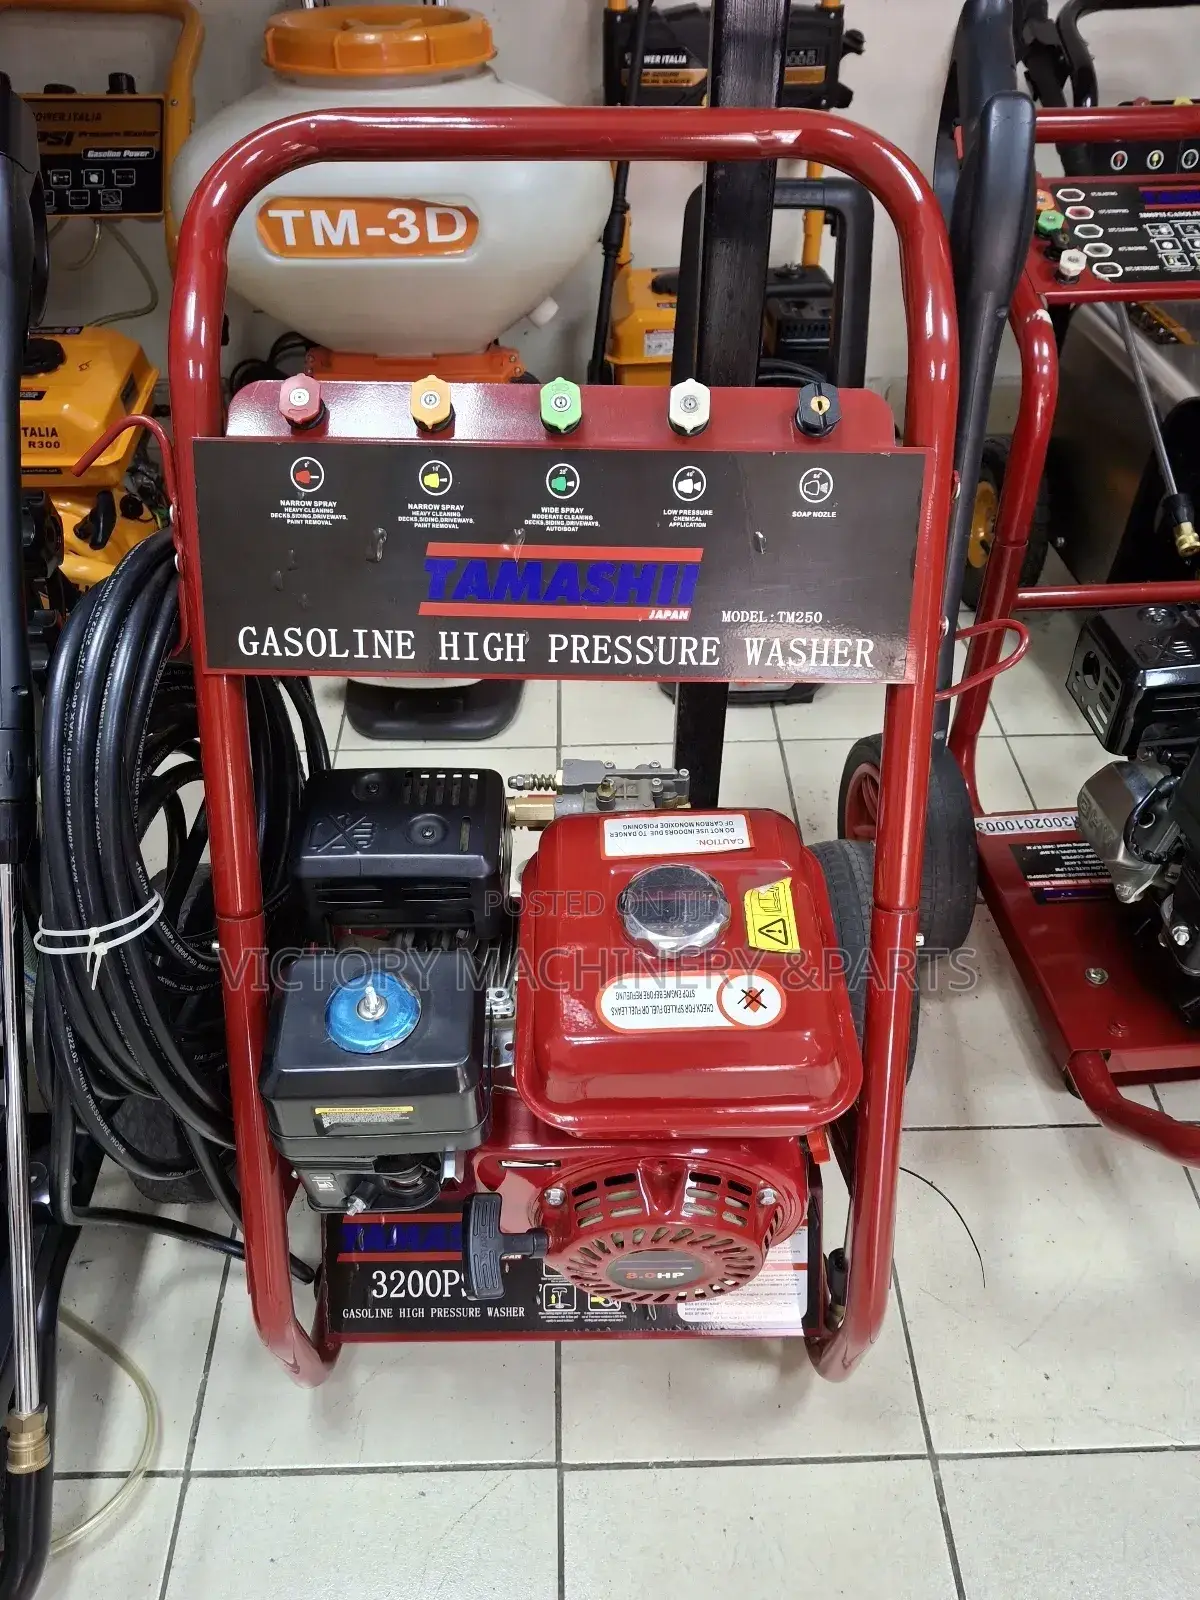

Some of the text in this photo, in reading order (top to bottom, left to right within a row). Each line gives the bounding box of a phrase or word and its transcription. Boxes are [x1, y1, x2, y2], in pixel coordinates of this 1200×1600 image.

[643, 55, 661, 63] WER
[268, 206, 468, 247] TM-3D
[22, 427, 59, 437] TALIA
[28, 441, 61, 449] R300
[424, 558, 700, 605] TAMASHII
[648, 609, 690, 620] JAPAN
[238, 626, 876, 669] GASOLINE HIGH PRESSURE WASHER
[696, 838, 744, 846] CAUTION:
[615, 989, 696, 1000] STOP ENGINE BEFORE REFUELING
[611, 1006, 628, 1016] LEAKS
[650, 1004, 663, 1014] FUEL
[664, 1004, 684, 1014] SPILLED
[685, 1004, 695, 1013] FOR
[696, 1003, 714, 1013] CHECK
[85, 1094, 111, 1137] PRESSURE
[342, 1307, 525, 1319] GASOLINE HIGH PRESSURE WASHER
